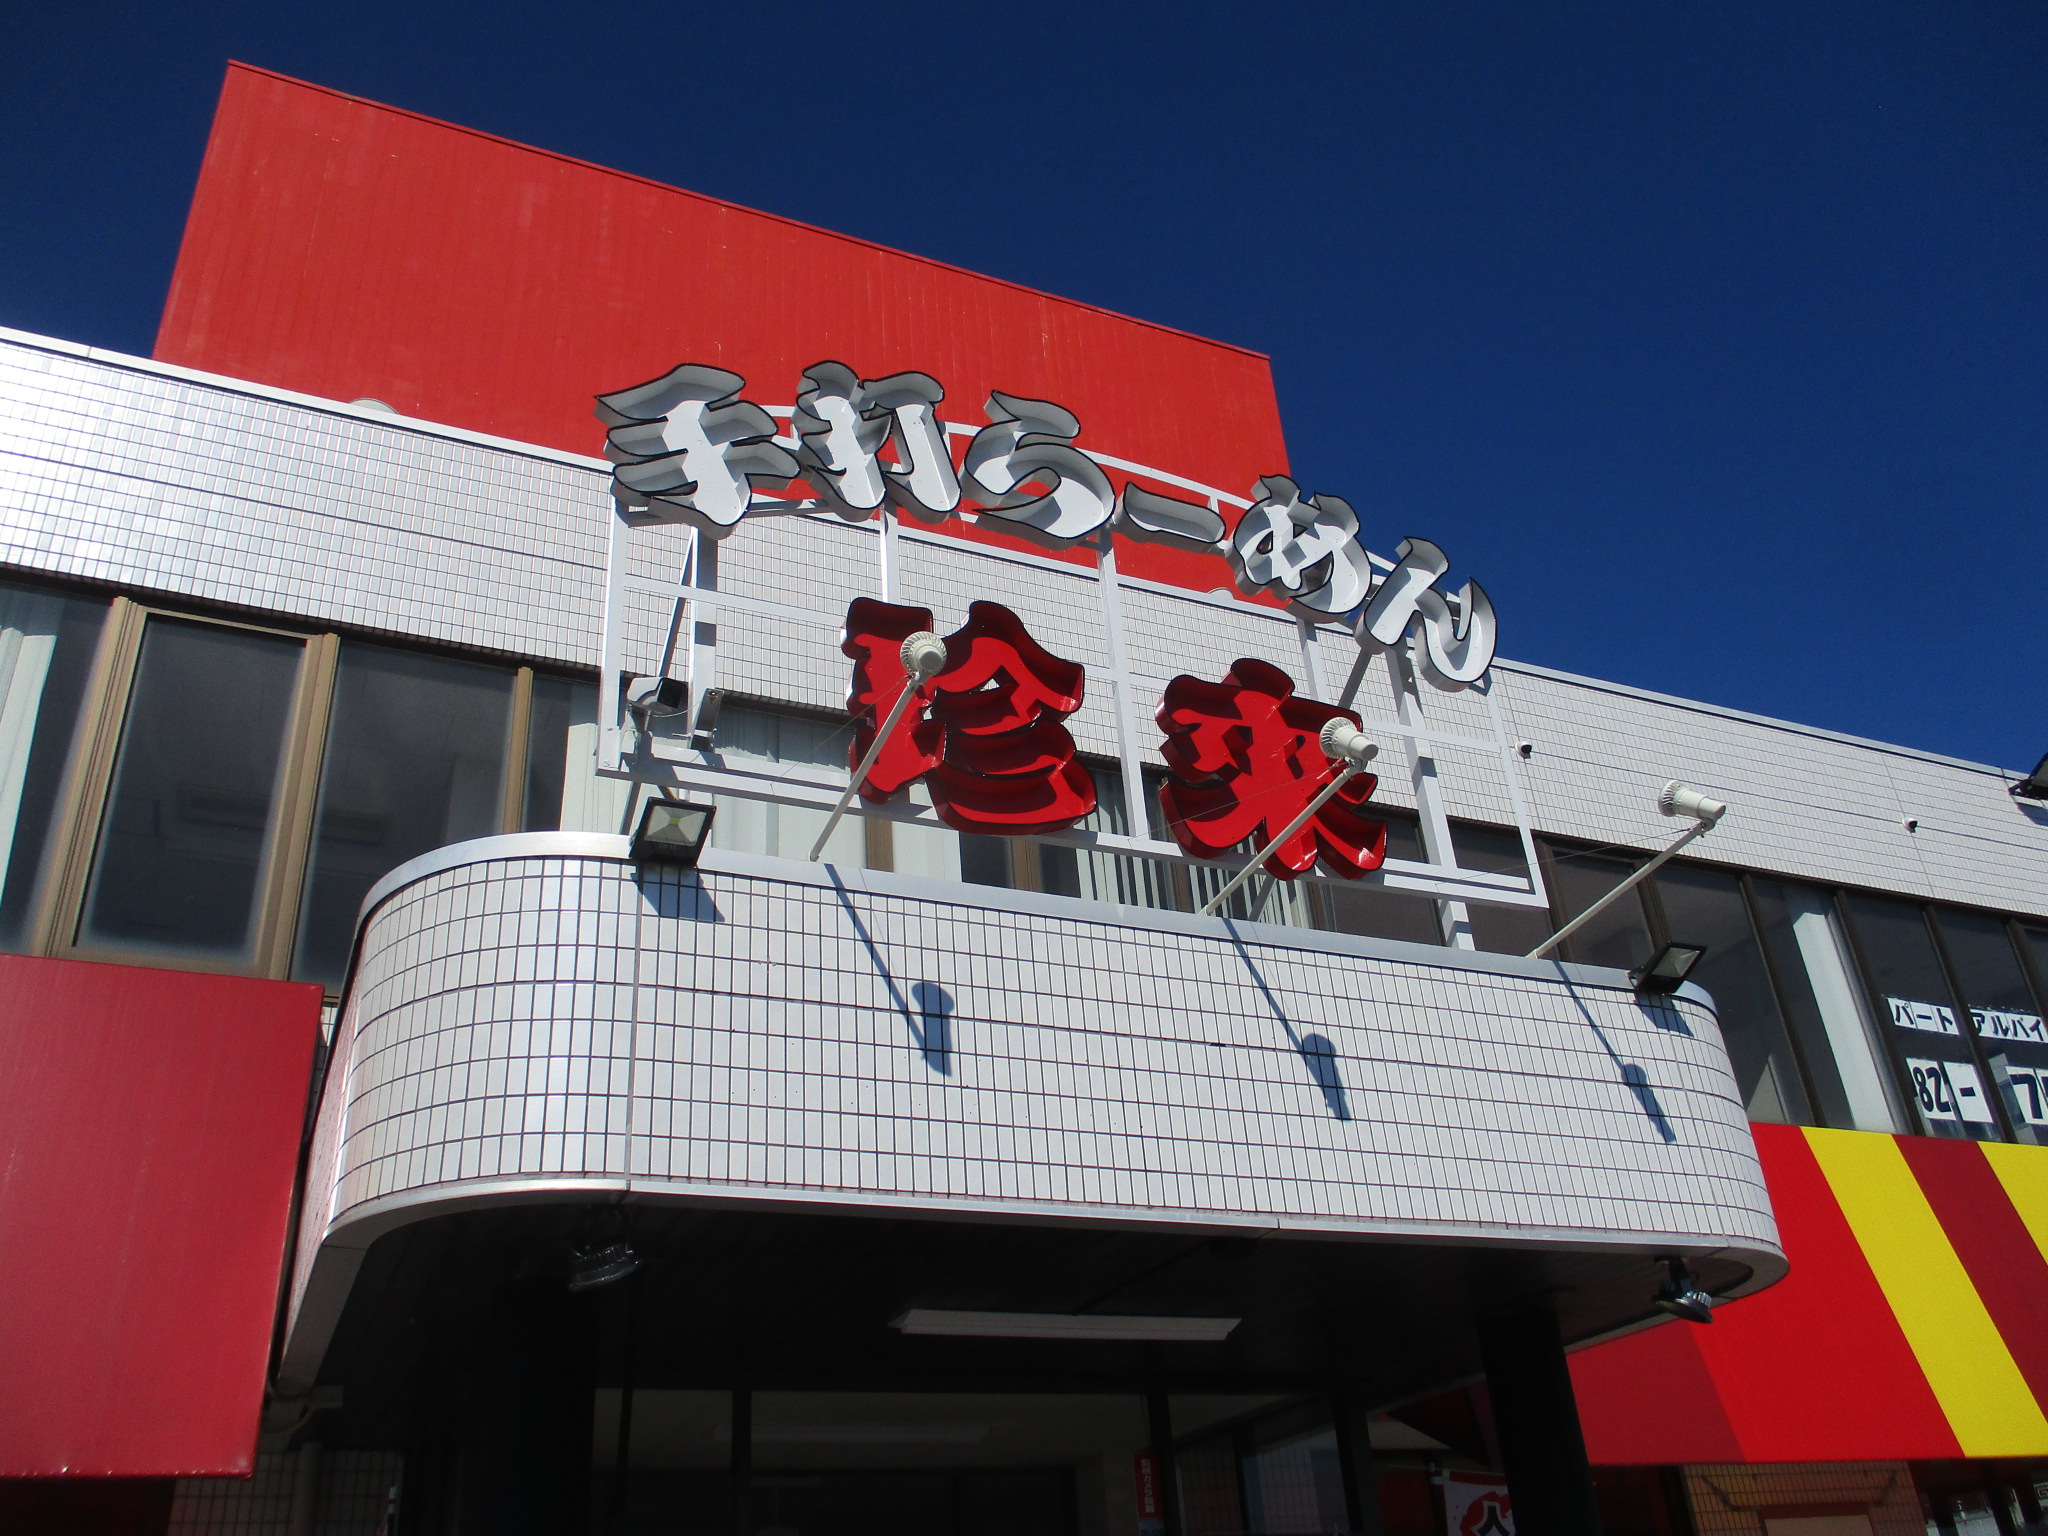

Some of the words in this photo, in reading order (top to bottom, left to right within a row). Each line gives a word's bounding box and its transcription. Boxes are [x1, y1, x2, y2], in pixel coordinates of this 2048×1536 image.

[595, 360, 1497, 691] 手打らーめん
[1894, 1002, 1954, 1032] パート
